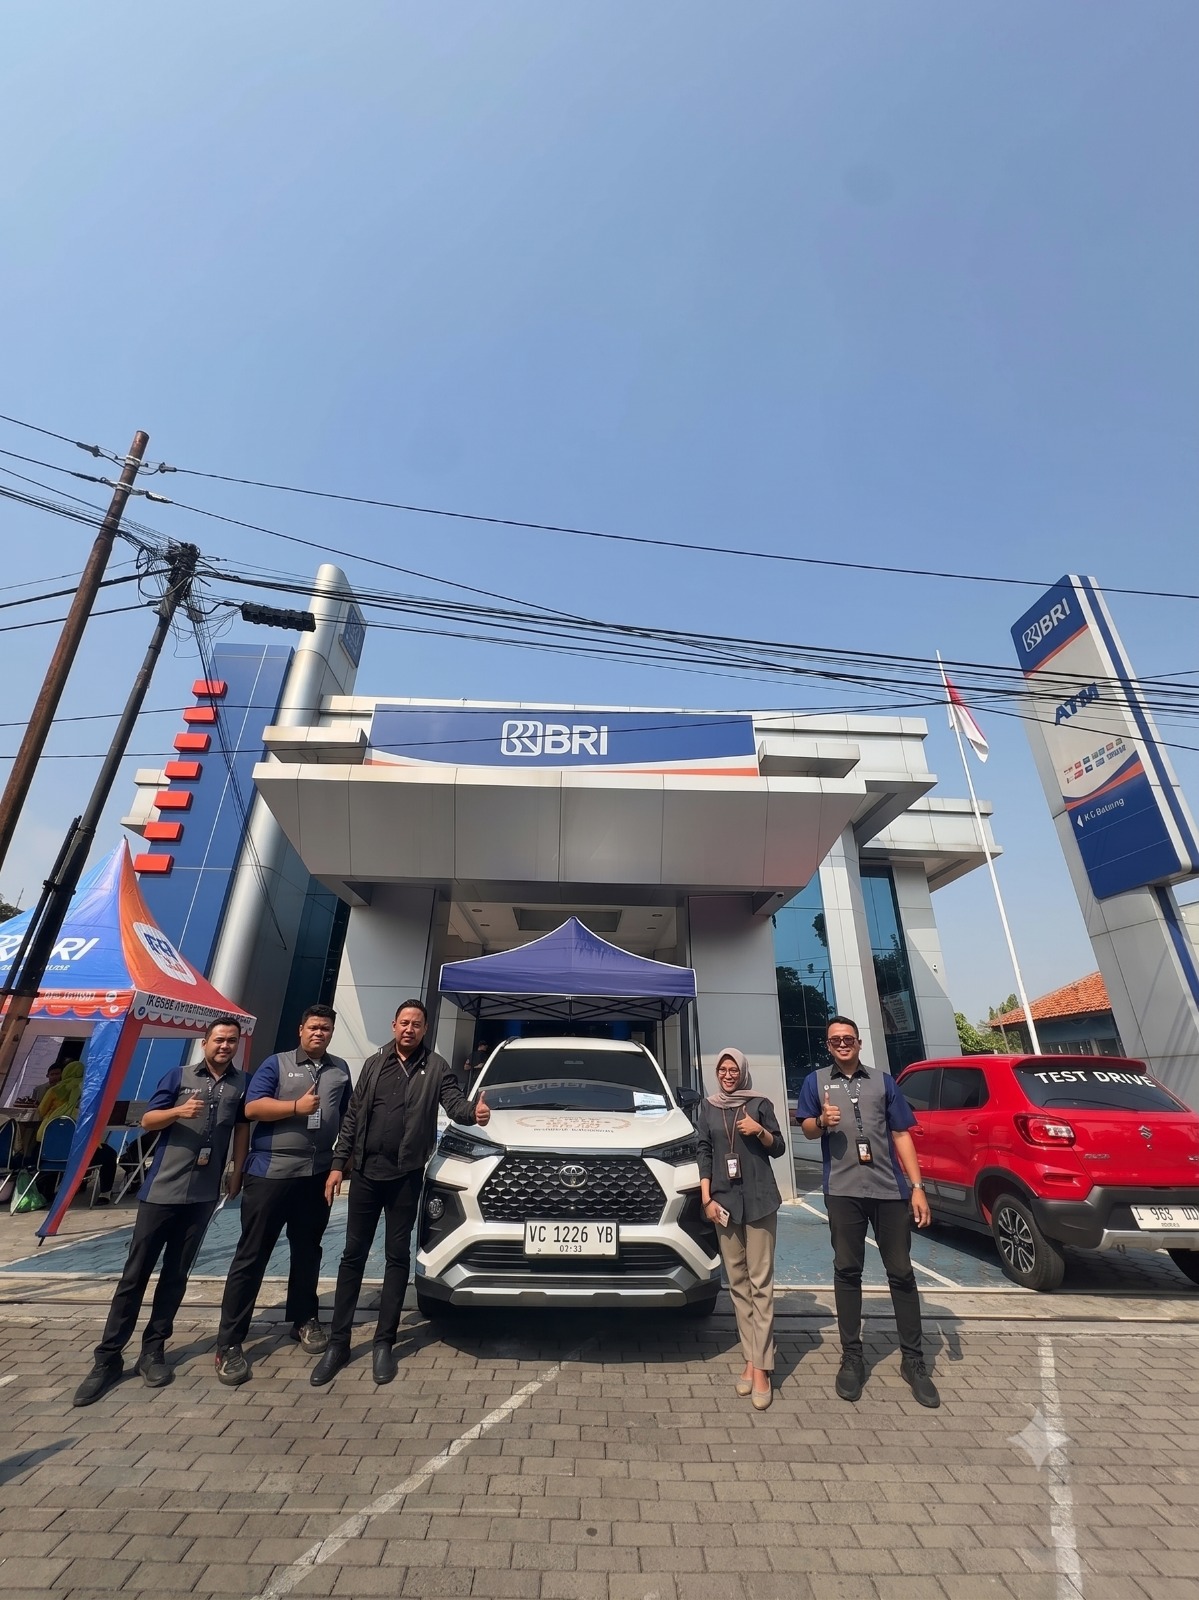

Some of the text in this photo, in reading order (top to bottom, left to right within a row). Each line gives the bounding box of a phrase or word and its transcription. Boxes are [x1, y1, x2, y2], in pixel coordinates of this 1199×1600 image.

[1040, 597, 1071, 636] BRI
[1055, 682, 1100, 726] ATM
[544, 724, 608, 756] BRI
[1034, 1071, 1157, 1088] TEST DRIVE
[529, 1225, 613, 1243] VC 1226 YB
